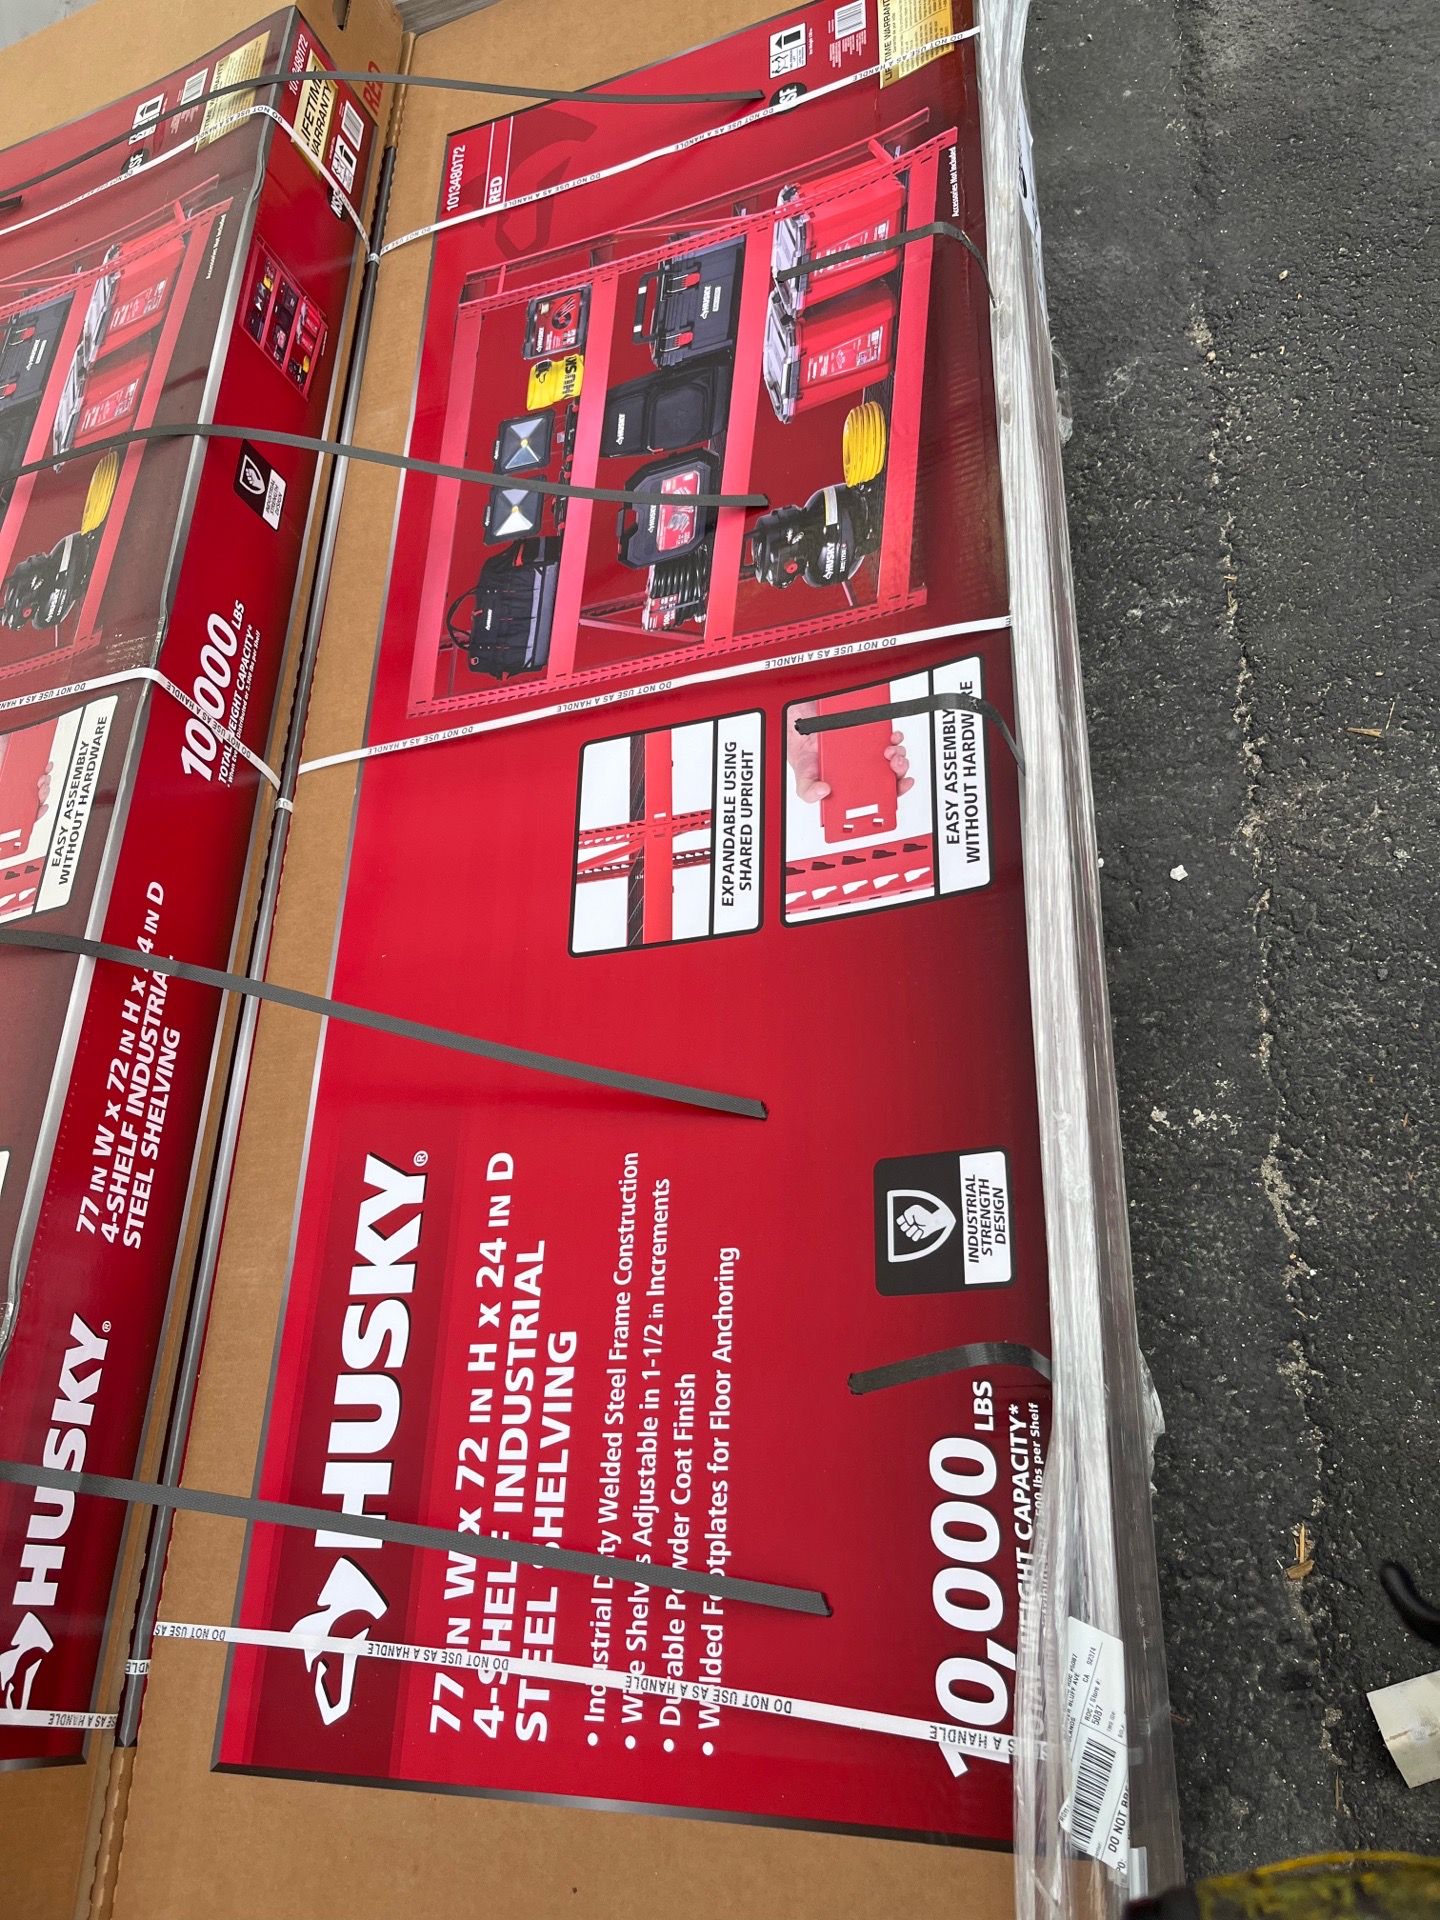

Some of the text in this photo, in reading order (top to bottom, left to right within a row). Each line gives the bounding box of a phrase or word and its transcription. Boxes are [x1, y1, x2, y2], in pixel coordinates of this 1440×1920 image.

[883, 40, 893, 82] LIFTIME
[301, 66, 322, 146] IFETIM
[779, 85, 797, 104] SF
[447, 145, 465, 211] 1013480172
[487, 175, 503, 205] RED
[948, 145, 960, 218] Accessories Not Included
[231, 599, 245, 631] LBS
[763, 637, 897, 670] DO NOT USE AS A HANDLE
[217, 745, 233, 784] TOTAL
[942, 709, 961, 845] EASY ASSEMBLY
[960, 681, 980, 863] WITHOUT HARDWRE
[51, 740, 89, 867] EASY ASSEMBLY
[58, 716, 107, 885] WITHOUT HARDWARE
[721, 740, 738, 907] EXPANDABLE USING
[738, 749, 754, 892] SHARED UPRIGHT
[147, 882, 164, 905] D
[144, 909, 160, 934] IN
[122, 999, 141, 1024] H
[130, 975, 147, 998] x
[119, 1029, 135, 1055] IN
[101, 955, 174, 1243] 4-SHELF INDUSTRIA
[107, 1058, 130, 1093] 72
[105, 1100, 121, 1121] x
[92, 1124, 115, 1156] W
[123, 1026, 180, 1249] STEEL SHELVING
[90, 1166, 107, 1192] IN
[486, 1152, 513, 1181] D
[76, 1196, 99, 1234] 77
[488, 1195, 511, 1227] IN
[613, 1152, 639, 1285] Construction
[964, 1174, 980, 1264] INDUSTRIAL
[978, 1178, 993, 1257] STRENGTH
[991, 1186, 1007, 1245] DESIGN
[476, 1238, 506, 1288] 24
[478, 1301, 501, 1328] x
[608, 1292, 631, 1360] Frame
[712, 1248, 740, 1363] Anchoring
[467, 1344, 497, 1371] H
[493, 1240, 545, 1513] INDUSTRIAL
[469, 1388, 493, 1423] IN
[604, 1368, 627, 1424] Steel
[709, 1370, 731, 1430] Floor
[455, 1438, 488, 1490] 72
[531, 1331, 577, 1568] HELVING
[621, 1178, 670, 1723] Wie Shelvs Adjustable in 1-1/2 in Increments
[706, 1438, 730, 1472] for
[1028, 1402, 1045, 1489] lbs per Shelf
[598, 1433, 622, 1523] Welded
[458, 1507, 482, 1535] x
[443, 1550, 477, 1600] W
[593, 1530, 621, 1588] Dty
[660, 1373, 695, 1726] Duable Pwder Coat Finish
[929, 1381, 1015, 1778] 10,000 LBS
[1016, 1547, 1037, 1653] WEIGHT
[154, 1624, 227, 1641] DO NOT USE AS
[367, 1643, 510, 1672] DO NOT USE AS A HANDLE
[626, 1675, 793, 1715] DO NOT USE AS A HANDLE
[698, 1624, 722, 1729] Wlded
[1082, 1673, 1091, 1684] CA
[430, 1672, 464, 1734] 77
[929, 1725, 1003, 1751] A HANDLE
[1107, 1808, 1128, 1854] DO NOT
